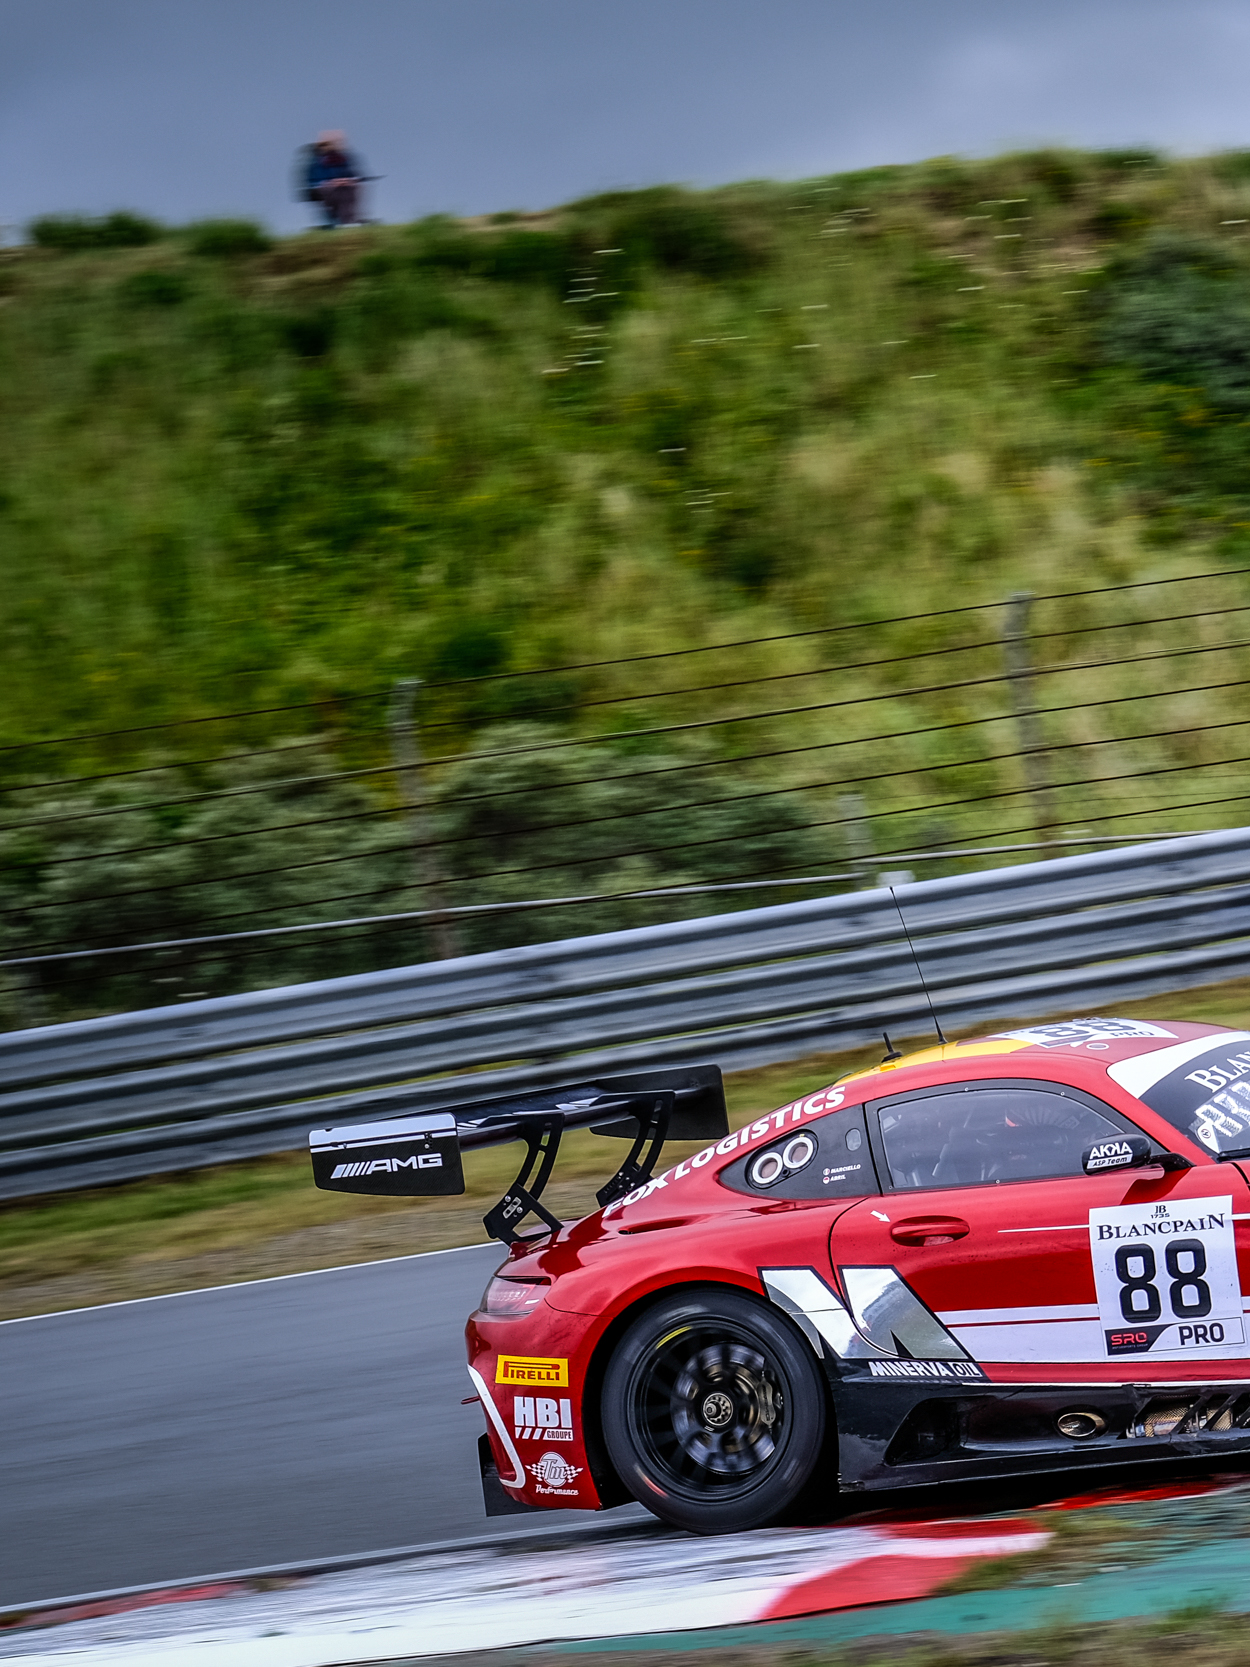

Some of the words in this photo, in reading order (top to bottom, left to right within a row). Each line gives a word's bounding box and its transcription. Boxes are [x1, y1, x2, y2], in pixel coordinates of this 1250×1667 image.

[602, 1171, 669, 1218] FOX
[674, 1086, 846, 1180] LOGISTICS
[1089, 1142, 1133, 1159] AKKA
[1107, 1157, 1127, 1165] Team
[366, 1153, 443, 1175] AMG
[1154, 1205, 1167, 1213] JB
[1097, 1213, 1225, 1240] BLANCPAIN
[1115, 1238, 1212, 1324] 88
[1111, 1332, 1147, 1345] SRO
[1179, 1323, 1225, 1345] PRO
[503, 1361, 560, 1381] PIRELLI
[867, 1361, 954, 1377] MINERVA
[950, 1361, 982, 1377] OIL
[514, 1396, 573, 1428] HBI
[547, 1430, 572, 1439] GROUPE
